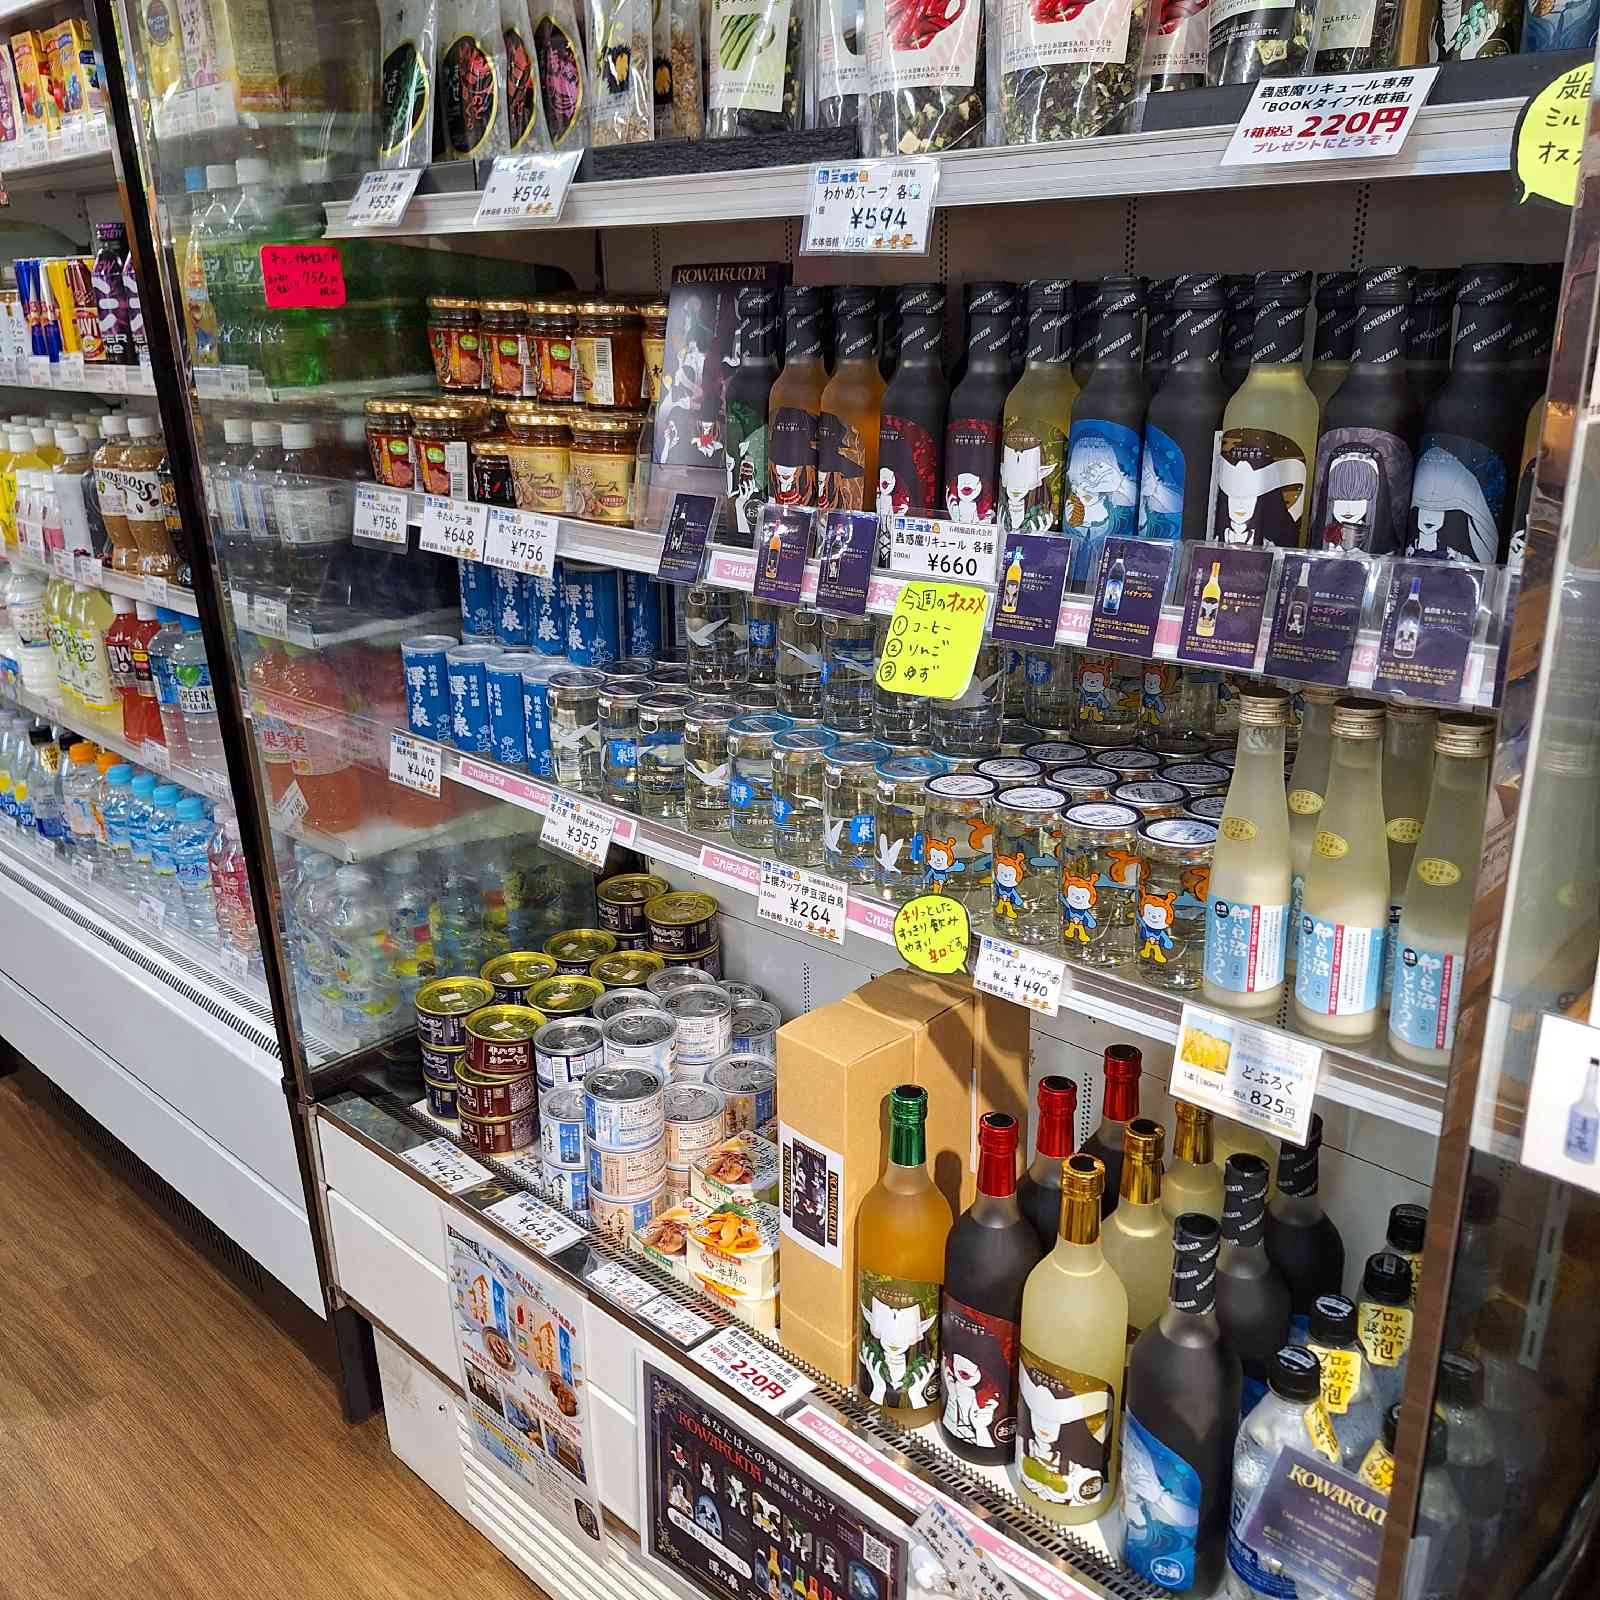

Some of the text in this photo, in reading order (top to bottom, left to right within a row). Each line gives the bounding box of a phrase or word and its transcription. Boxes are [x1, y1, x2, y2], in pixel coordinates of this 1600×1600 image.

[1259, 76, 1414, 98] 蟲惑魔リキュール専用
[1297, 106, 1409, 137] 220円
[511, 185, 551, 202] ¥594
[823, 186, 888, 200] わかめスープ
[850, 206, 908, 229] ¥594
[372, 514, 398, 531] ¥756
[498, 524, 548, 541] 食べるオイスター
[444, 526, 474, 546] ¥648
[895, 532, 994, 554] 蟲惑魔リキュール 各種
[511, 540, 543, 562] ¥756
[927, 553, 977, 576] ¥660
[902, 587, 986, 614] 今週の オススメ
[913, 620, 951, 634] コーヒー
[909, 639, 950, 657] りんご
[903, 665, 940, 683] ゆず
[407, 762, 434, 782] ¥440
[567, 825, 599, 851] ¥355
[789, 896, 831, 925] ¥264
[1014, 974, 1048, 997] ¥490
[1241, 1064, 1294, 1096] どぶろく
[1250, 1090, 1296, 1120] 825円
[431, 1158, 464, 1182] ¥429
[519, 1215, 557, 1242] ¥645
[1373, 1340, 1394, 1361] 泡
[730, 1359, 787, 1400] 220円
[701, 1413, 836, 1514] あなたはどの物語を選ぶ？
[1154, 1563, 1183, 1581] お酒
